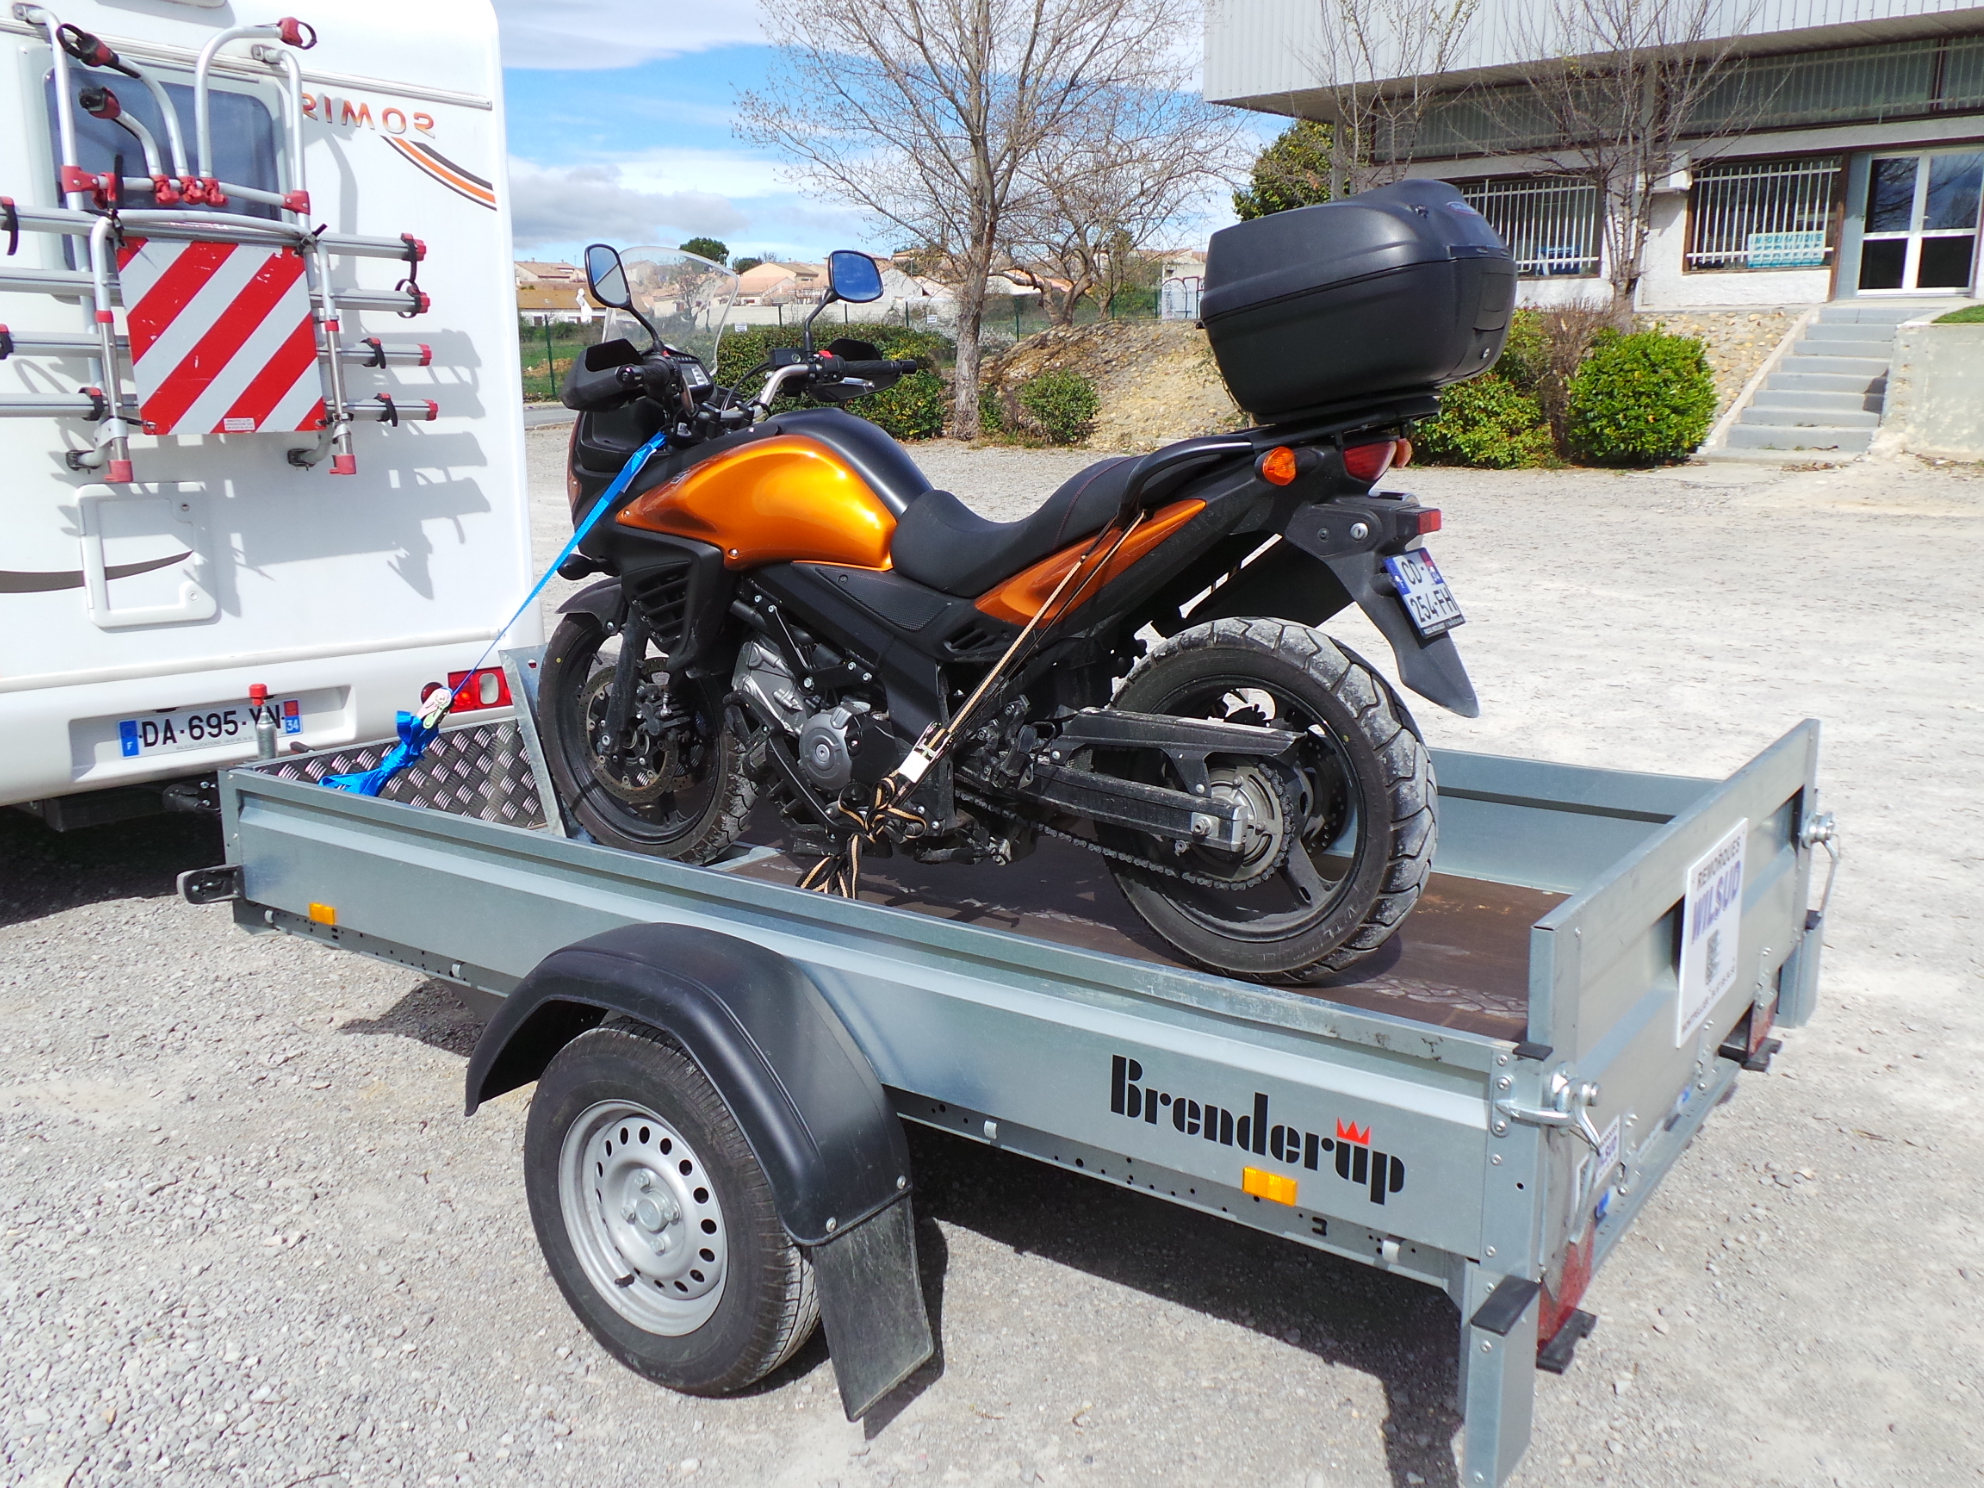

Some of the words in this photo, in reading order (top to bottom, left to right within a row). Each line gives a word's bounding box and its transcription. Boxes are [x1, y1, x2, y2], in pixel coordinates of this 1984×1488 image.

[301, 92, 436, 139] RIMOR
[286, 718, 299, 732] 34
[126, 741, 134, 751] F
[1110, 1054, 1406, 1206] Brenderup
